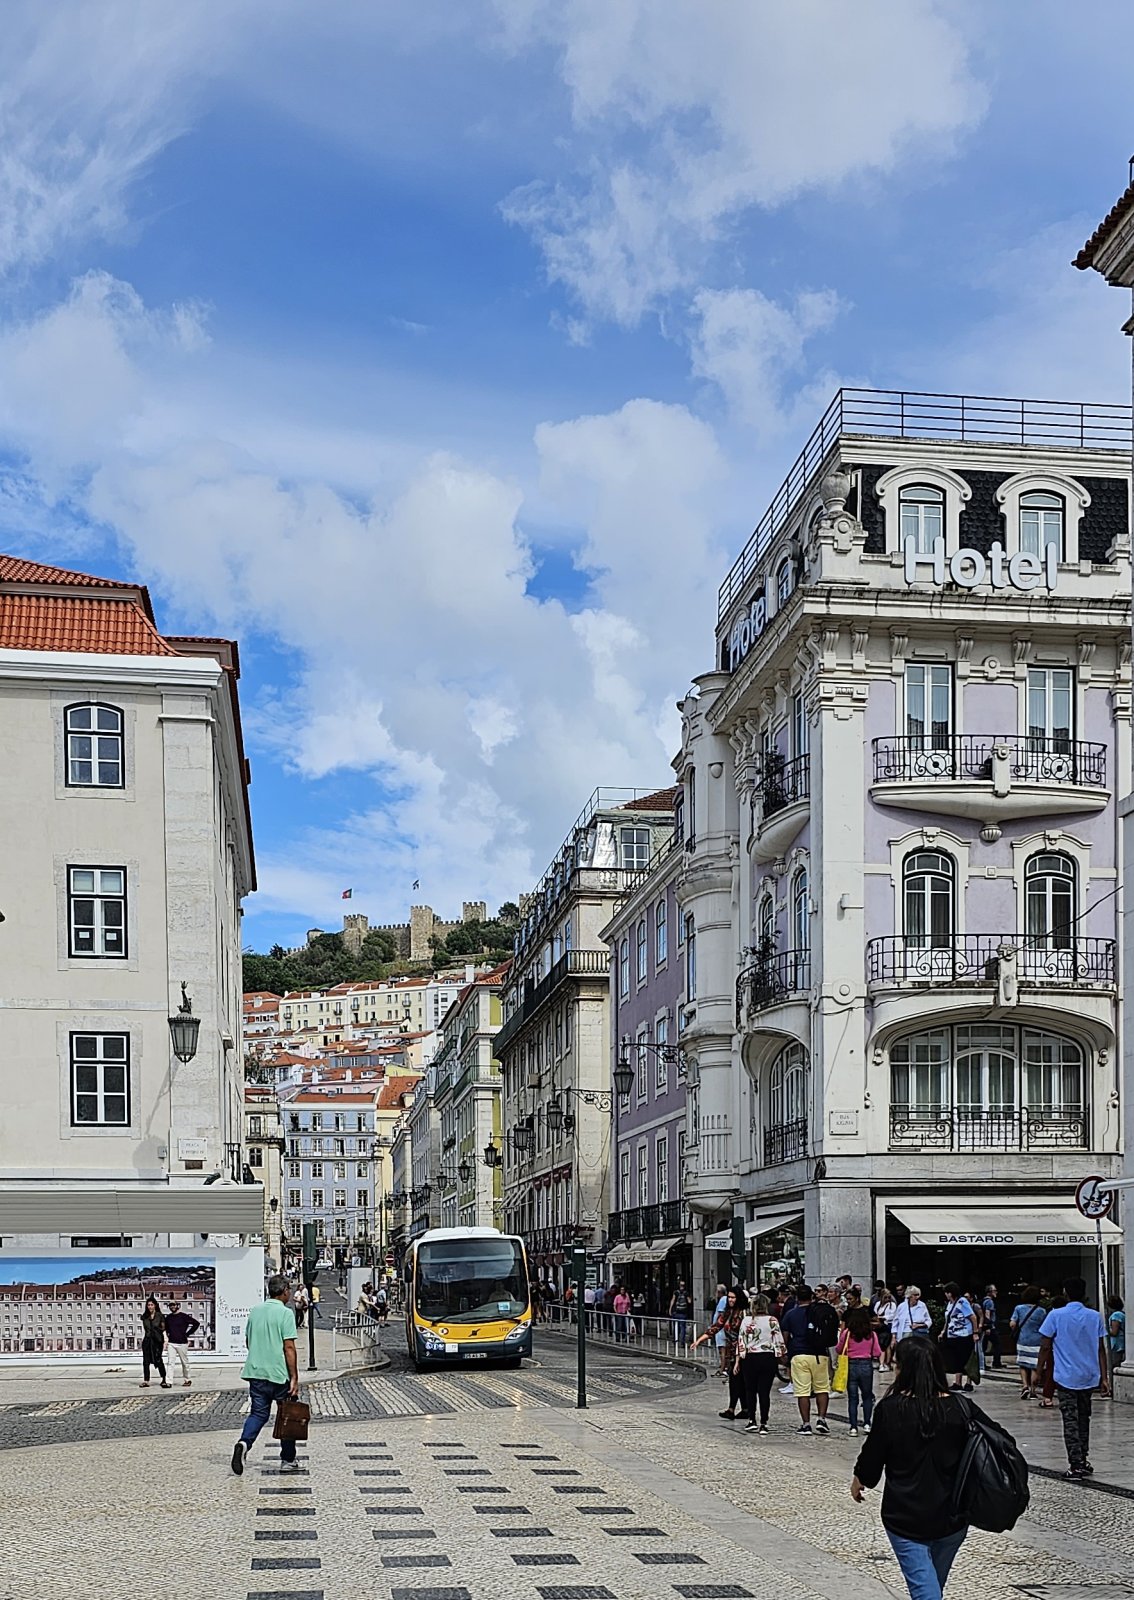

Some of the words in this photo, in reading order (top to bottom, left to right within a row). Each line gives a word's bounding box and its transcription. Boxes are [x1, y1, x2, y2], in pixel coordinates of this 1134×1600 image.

[904, 534, 1058, 591] Hotel
[729, 575, 777, 673] Hotel
[938, 1235, 1014, 1243] BASTARDO
[1036, 1235, 1065, 1243] FISH
[1068, 1235, 1096, 1243] BAR
